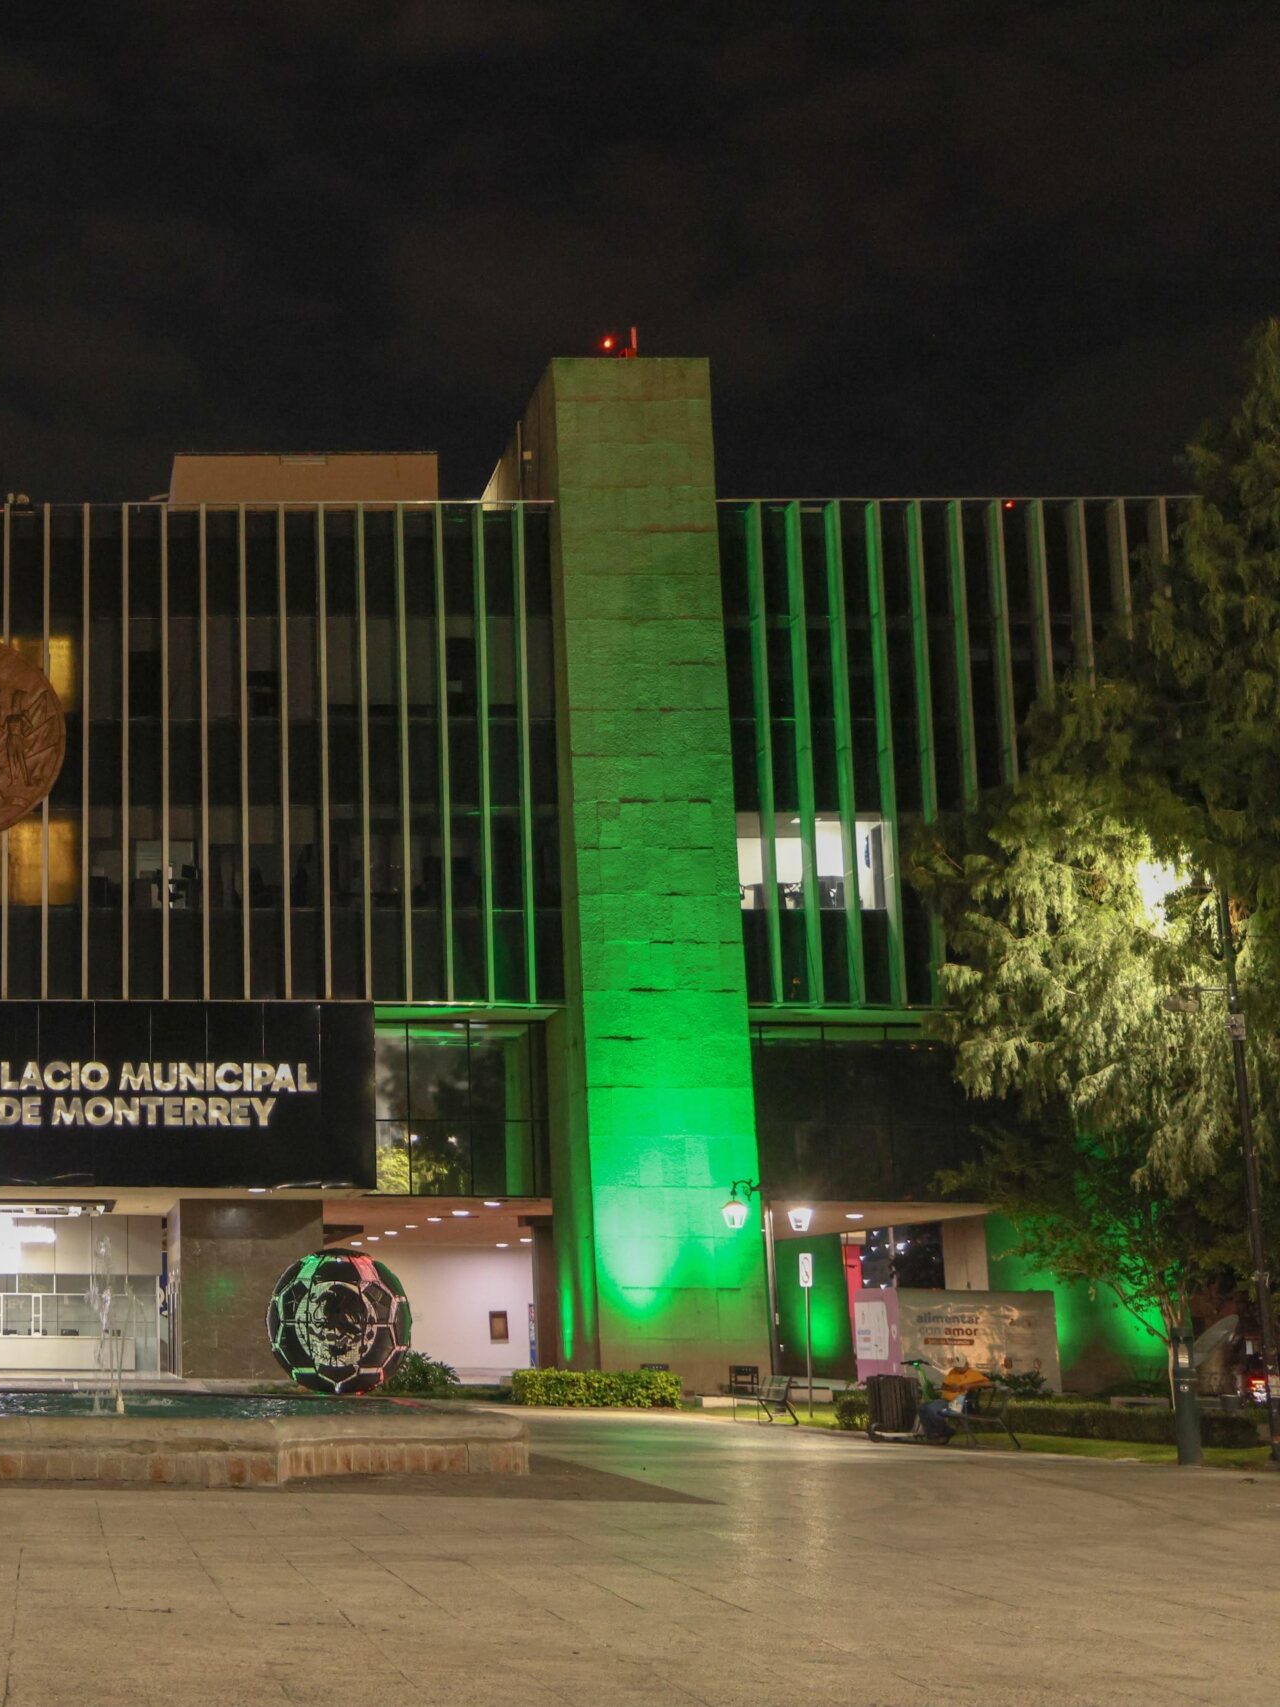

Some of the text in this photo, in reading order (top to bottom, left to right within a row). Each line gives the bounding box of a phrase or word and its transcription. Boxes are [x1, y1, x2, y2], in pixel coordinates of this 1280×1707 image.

[119, 1062, 318, 1092] MUNICIPAL
[51, 1097, 276, 1126] MONTERREY
[916, 1312, 980, 1325] alimentar
[944, 1327, 979, 1336] amor
